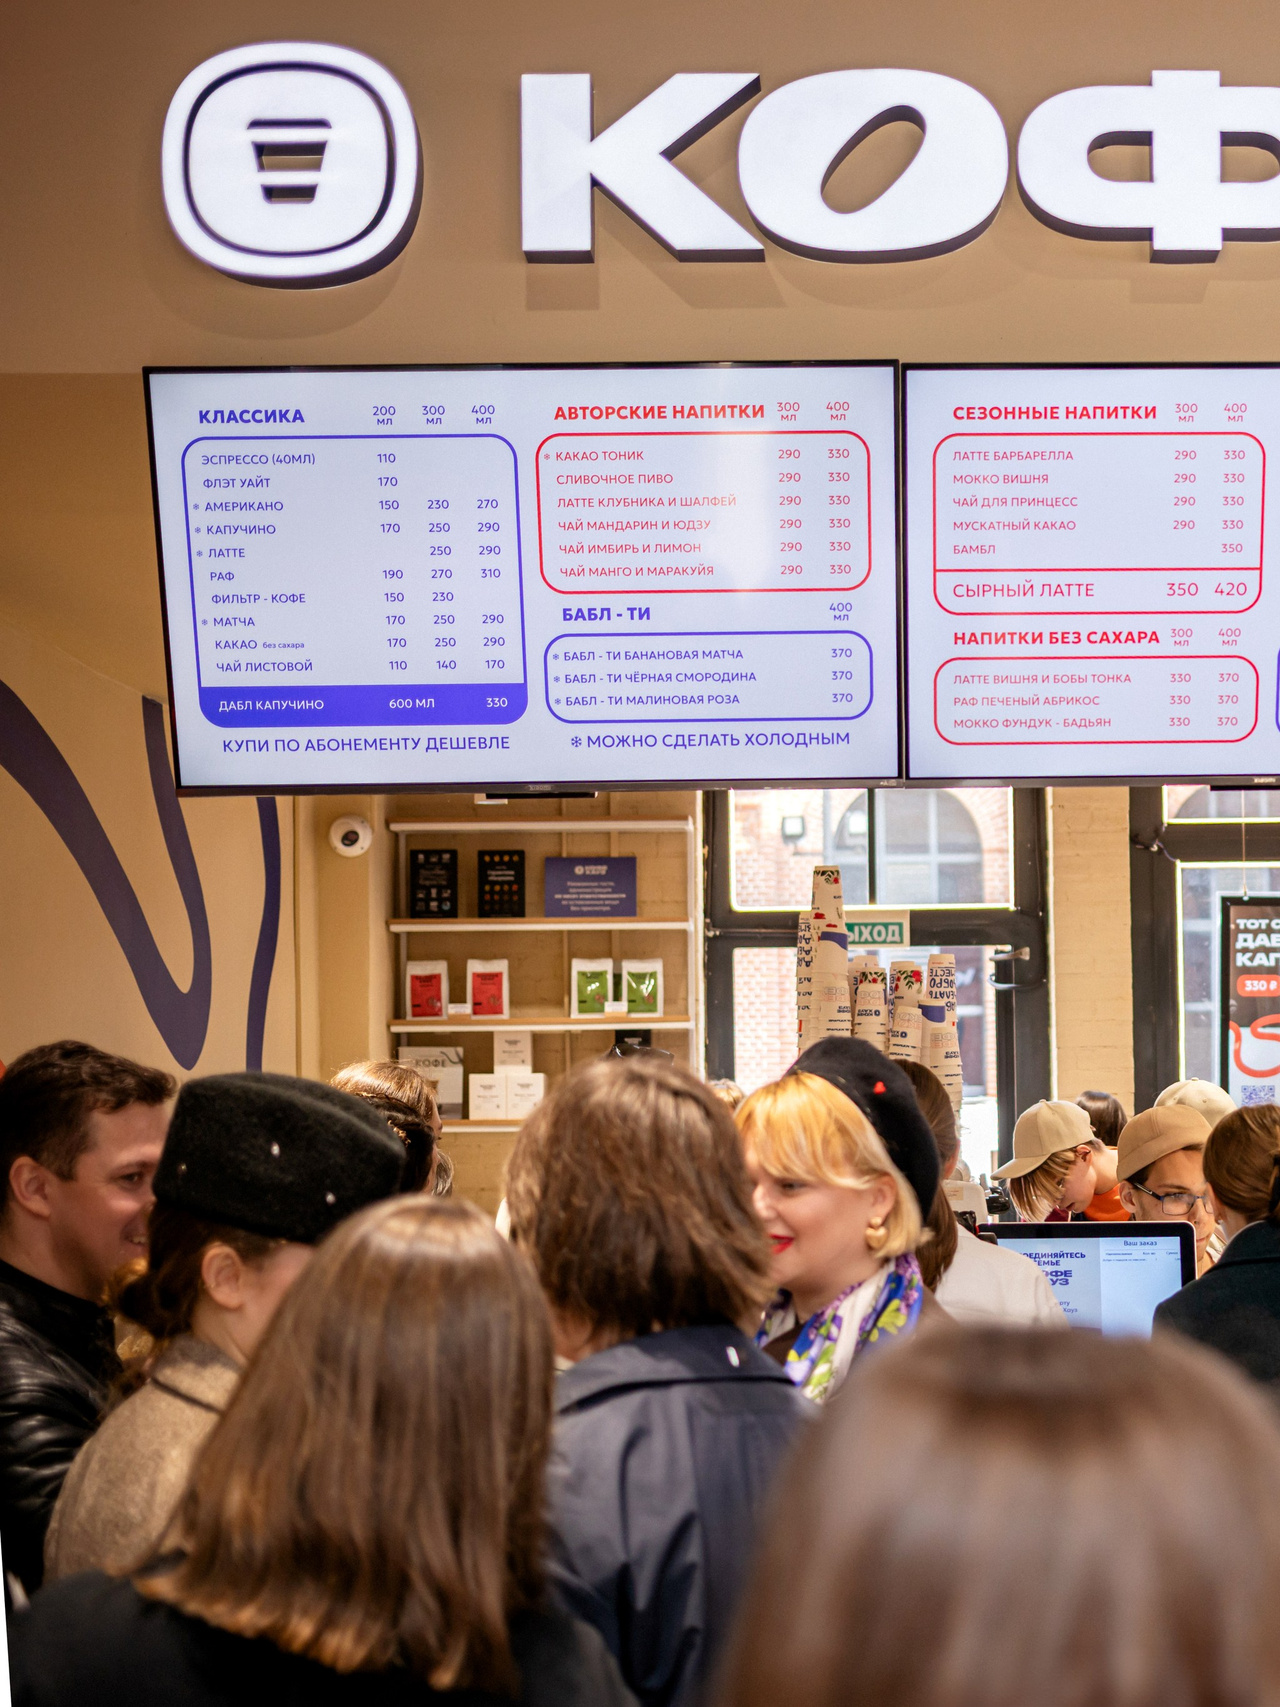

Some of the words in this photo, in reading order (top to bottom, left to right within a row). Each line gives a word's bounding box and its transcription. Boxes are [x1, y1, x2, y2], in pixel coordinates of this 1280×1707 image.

[199, 409, 305, 424] КЛАССИКА
[554, 406, 667, 420] АВТОРСКИЕ
[673, 405, 764, 419] НАПИТКИ
[953, 406, 1059, 420] СЕЗОННЫЕ
[1066, 406, 1156, 419] НАПИТКИ
[202, 455, 268, 465] ЭСПРЕССО
[272, 453, 315, 465] (40МЛ)
[377, 453, 396, 463] 110
[953, 451, 989, 460] ЛАТТЕ
[994, 451, 1073, 460] БАРБАРЕЛЛА
[203, 479, 236, 488] ФЛЭТ
[240, 475, 270, 488] УАЙТ
[378, 477, 398, 486] 170
[557, 475, 634, 485] СЛИВОЧНОЕ
[638, 474, 673, 483] ПИВО
[779, 473, 801, 482] 290
[828, 472, 850, 482] 330
[954, 475, 999, 484] МОККО
[1003, 474, 1048, 484] ВИШНЯ
[205, 501, 283, 511] АМЕРИКАНО
[379, 500, 399, 510] 150
[428, 500, 449, 509] 230
[477, 499, 498, 509] 270
[558, 498, 594, 507] ЛАТТЕ
[598, 498, 665, 507] КЛУБНИКА
[668, 497, 676, 506] И
[681, 494, 735, 506] ШАЛФЕЙ
[207, 525, 276, 534] КАПУЧИНО
[558, 519, 583, 531] ЧАЙ
[587, 521, 657, 532] МАНДАРИН
[662, 521, 669, 529] И
[674, 520, 710, 531] ЮДЗУ
[954, 518, 1030, 530] МУСКАТНЫЙ
[1034, 521, 1076, 530] КАКАО
[209, 548, 245, 558] ЛАТТЕ
[954, 545, 995, 554] БАМБЛ
[210, 572, 234, 581] РАФ
[953, 579, 1034, 597] СЫРНЫЙ
[1040, 583, 1094, 597] ЛАТТЕ
[1167, 583, 1198, 596] 350
[1215, 582, 1247, 596] 420
[563, 608, 611, 621] БАБЛ
[627, 607, 650, 620] ТИ
[214, 617, 255, 626] МАТЧА
[954, 632, 1043, 645] НАПИТКИ
[1049, 631, 1081, 644] БЕЗ
[1087, 631, 1160, 644] САХАРА
[215, 640, 257, 649] КАКАО
[217, 660, 241, 672] ЧАЙ
[245, 659, 312, 671] ЛИСТОВОЙ
[218, 701, 253, 712] ДАБЛ
[256, 700, 324, 710] КАПУЧИНО
[389, 699, 412, 708] 600
[416, 699, 434, 708] МЛ
[486, 698, 508, 707] 330
[954, 697, 978, 706] РАФ
[982, 694, 1039, 706] ПЕЧЕНЫЙ
[1043, 696, 1099, 705] АБРИКОС
[223, 740, 269, 752] КУПИ
[275, 739, 300, 752] ПО
[305, 738, 421, 751] АБОНЕМЕНТУ
[426, 737, 510, 753] ДЕШЕВЛЕ
[587, 735, 657, 748] МОЖНО
[662, 734, 740, 749] СДЕЛАТЬ
[745, 732, 849, 748] ХОЛОДНЫМ
[1236, 919, 1269, 930] ТОТ
[848, 925, 900, 942] ЫХОД
[929, 968, 955, 977] МЕСТЕ
[929, 977, 956, 989] ОБРО
[1244, 980, 1267, 991] 330
[929, 990, 956, 999] ЕЛАТЬ
[1022, 1250, 1086, 1259] ОЕДИНЯЙТЕСЬ
[1043, 1270, 1072, 1278] ОФЕ
[1050, 1278, 1070, 1286] УЗ
